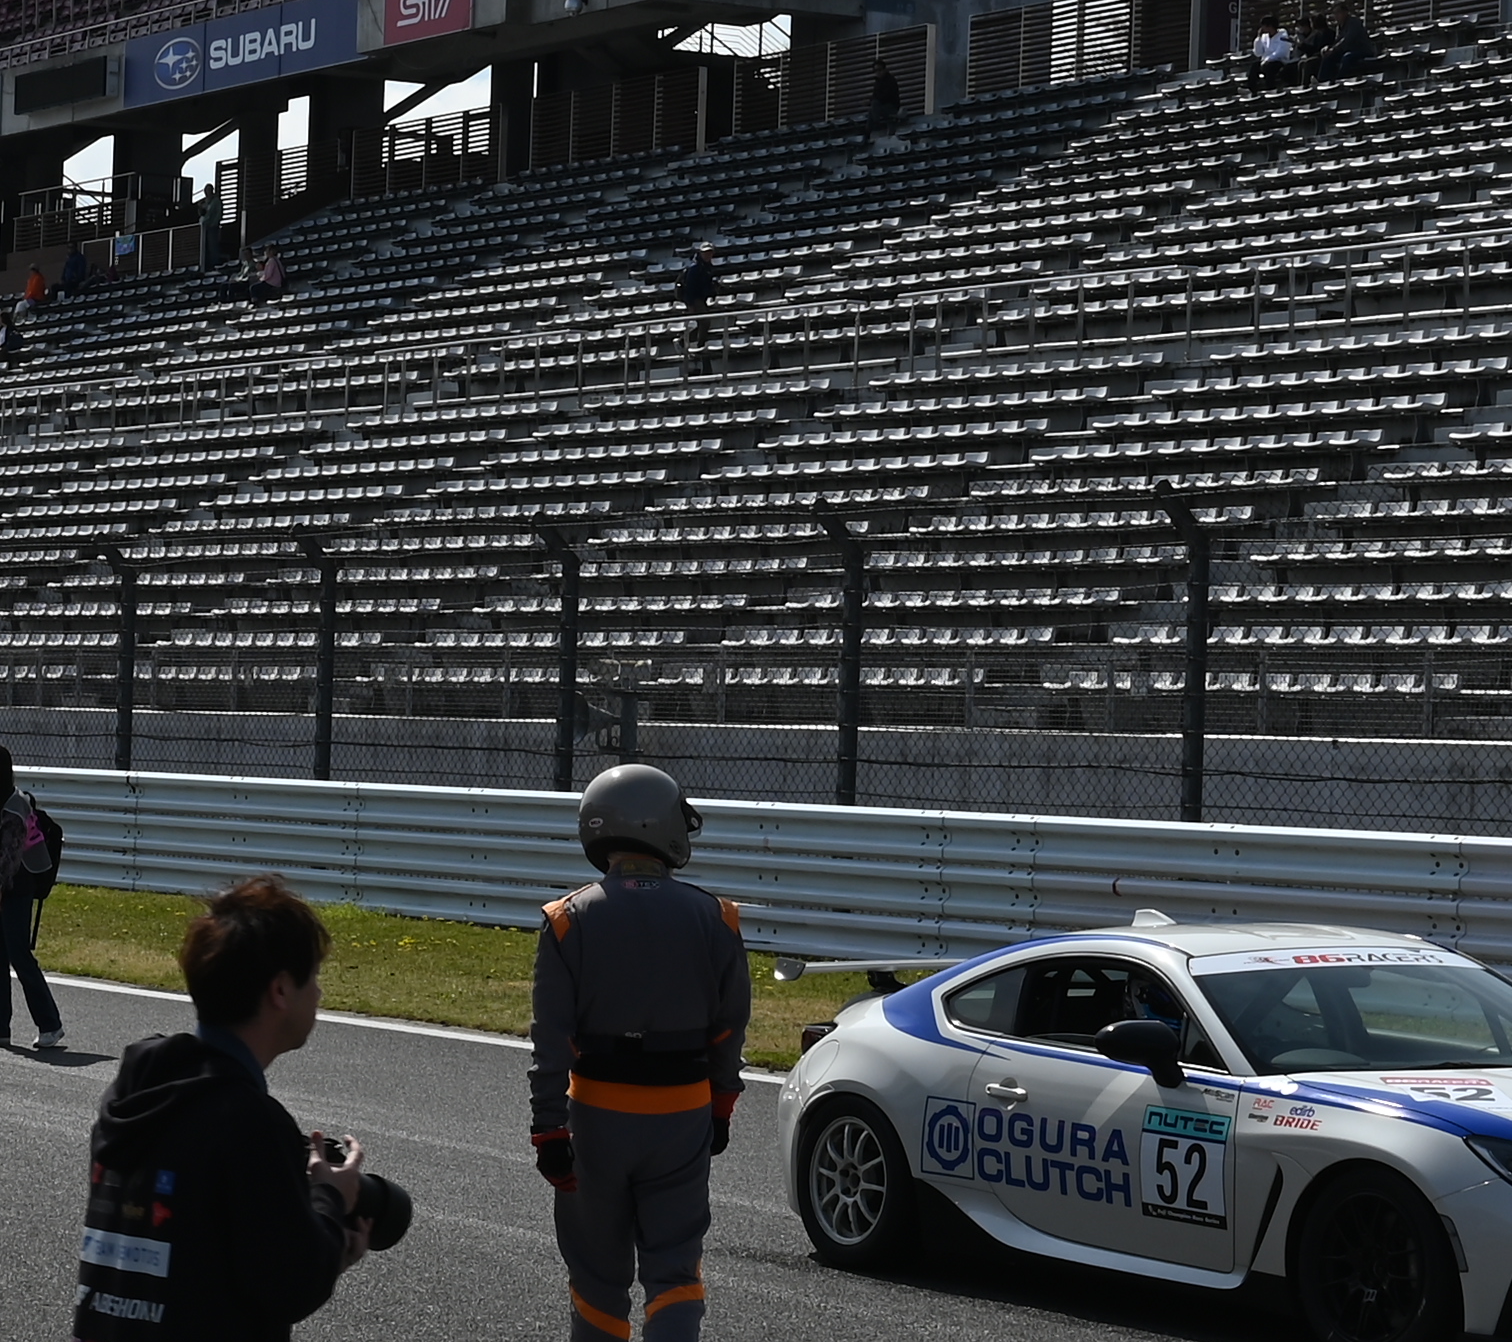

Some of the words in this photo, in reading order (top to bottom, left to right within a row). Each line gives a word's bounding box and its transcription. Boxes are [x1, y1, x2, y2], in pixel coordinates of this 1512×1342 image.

[208, 17, 317, 70] SUBARU
[1409, 1086, 1496, 1101] 52
[976, 1107, 1131, 1167] OGURA
[1272, 1114, 1323, 1132] BRIDE
[976, 1146, 1133, 1208] CLUTCH
[1155, 1137, 1209, 1211] 52
